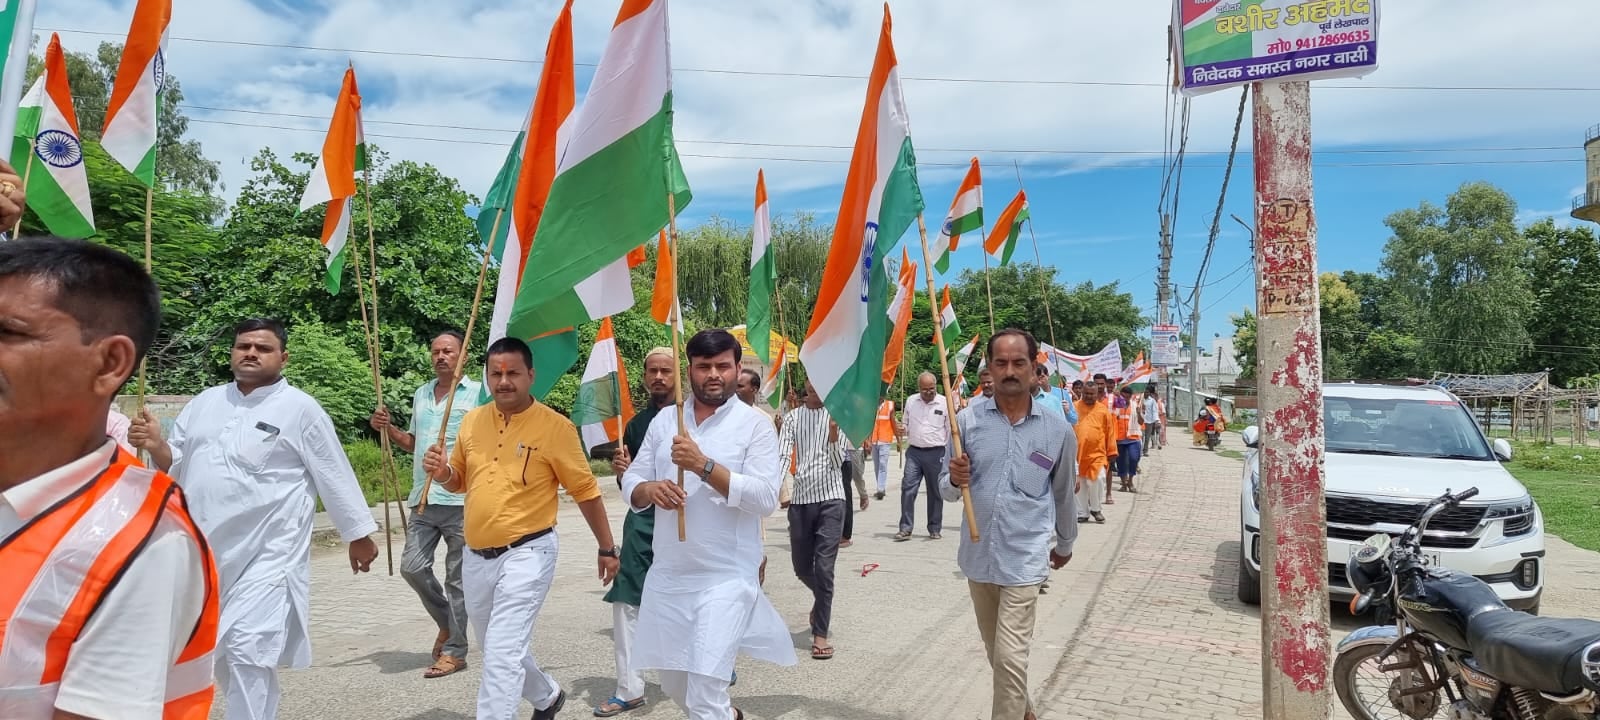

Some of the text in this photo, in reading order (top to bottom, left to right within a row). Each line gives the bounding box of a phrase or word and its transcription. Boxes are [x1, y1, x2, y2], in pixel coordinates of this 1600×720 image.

[1215, 0, 1370, 35] बशीर अहमद
[1295, 30, 1370, 50] 9412869635
[1192, 45, 1369, 83] निवेदक समस्त नगर वासी
